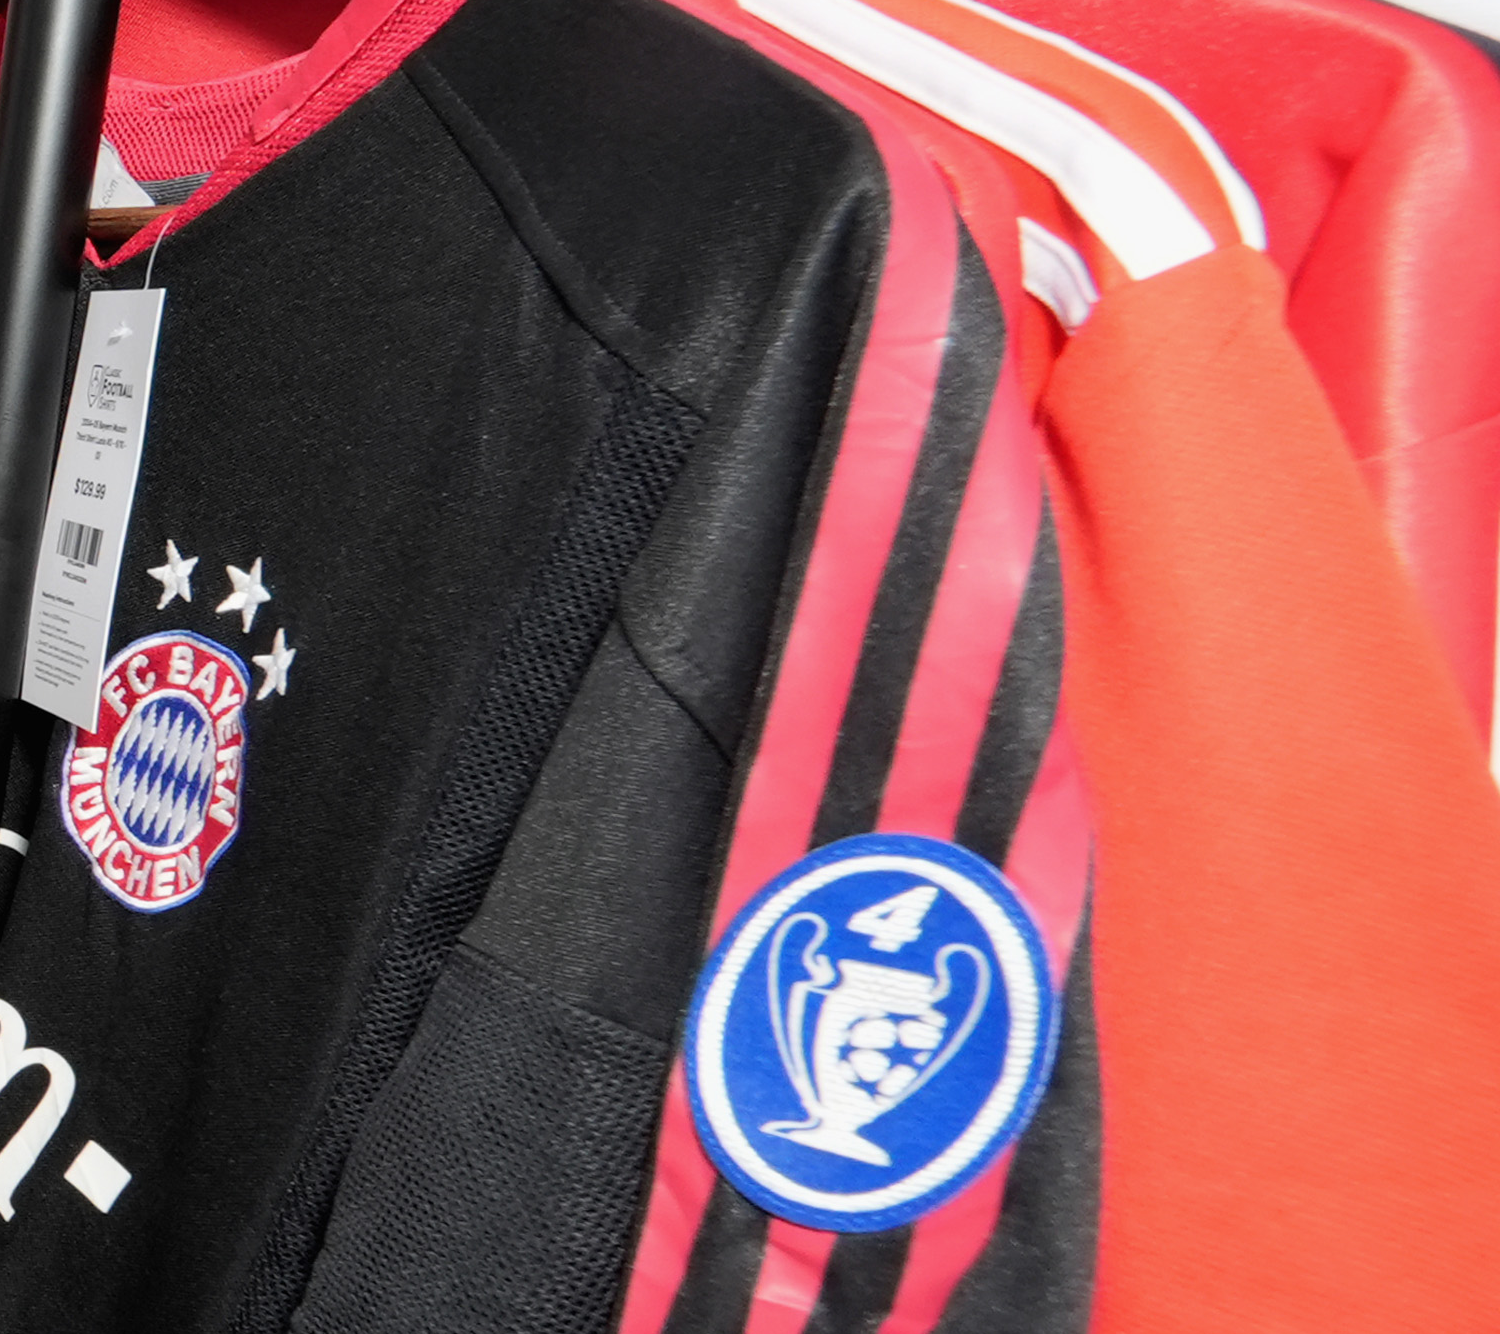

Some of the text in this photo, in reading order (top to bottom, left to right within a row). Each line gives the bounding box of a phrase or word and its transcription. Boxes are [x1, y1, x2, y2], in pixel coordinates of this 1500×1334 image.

[74, 477, 106, 500] $129.99
[102, 654, 155, 717] FC
[167, 645, 241, 827] BAYERN
[847, 885, 938, 952] 4
